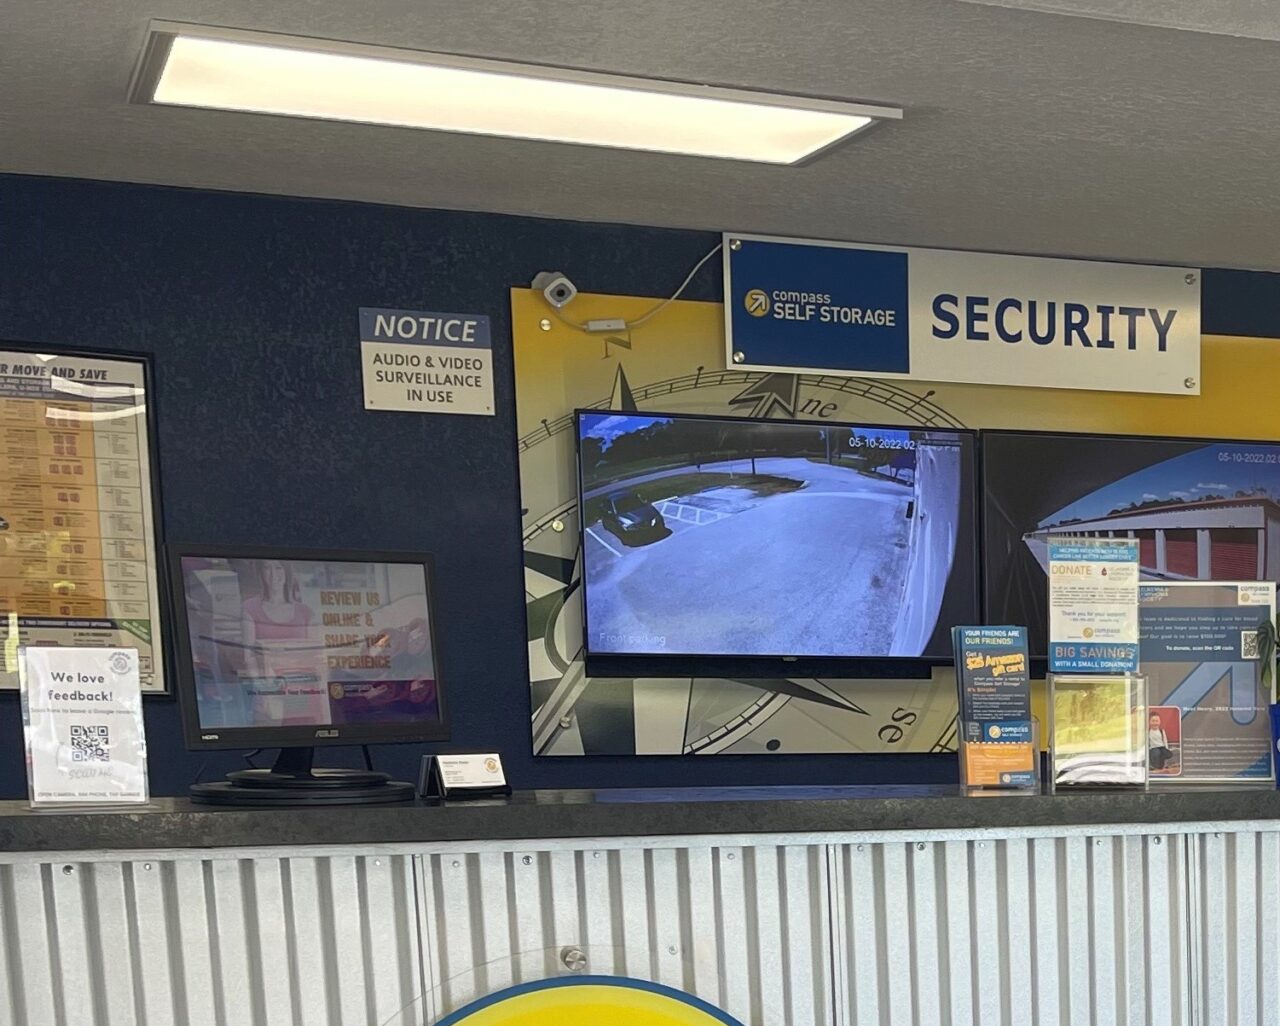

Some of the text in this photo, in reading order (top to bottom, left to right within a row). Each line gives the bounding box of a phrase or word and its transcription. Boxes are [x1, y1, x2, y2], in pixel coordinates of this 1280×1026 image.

[773, 290, 831, 305] compass
[773, 303, 896, 327] SELF STORAGE
[374, 314, 477, 342] NOTICE
[932, 293, 1177, 352] SECURITY
[373, 353, 483, 371] AUDIO & VIDEO
[12, 365, 46, 376] MOVE
[51, 367, 75, 378] AND
[80, 369, 108, 380] SAVE
[376, 370, 482, 387] SURVEILLANCE
[407, 389, 454, 403] IN USE
[800, 398, 837, 418] ne
[848, 437, 901, 449] 05-10-2022
[1051, 565, 1092, 575] DONATE
[320, 591, 380, 606] REVIEW US
[323, 613, 360, 627] ONLINE
[325, 634, 359, 648] SHARE
[600, 633, 625, 643] Front
[1055, 646, 1136, 659] BIG SAVINGS
[327, 656, 391, 669] EXPERIENCE
[986, 654, 1025, 667] Amazon
[1006, 663, 1025, 672] card
[51, 672, 105, 683] We love
[48, 690, 113, 702] feedback!
[1001, 726, 1028, 734] compass
